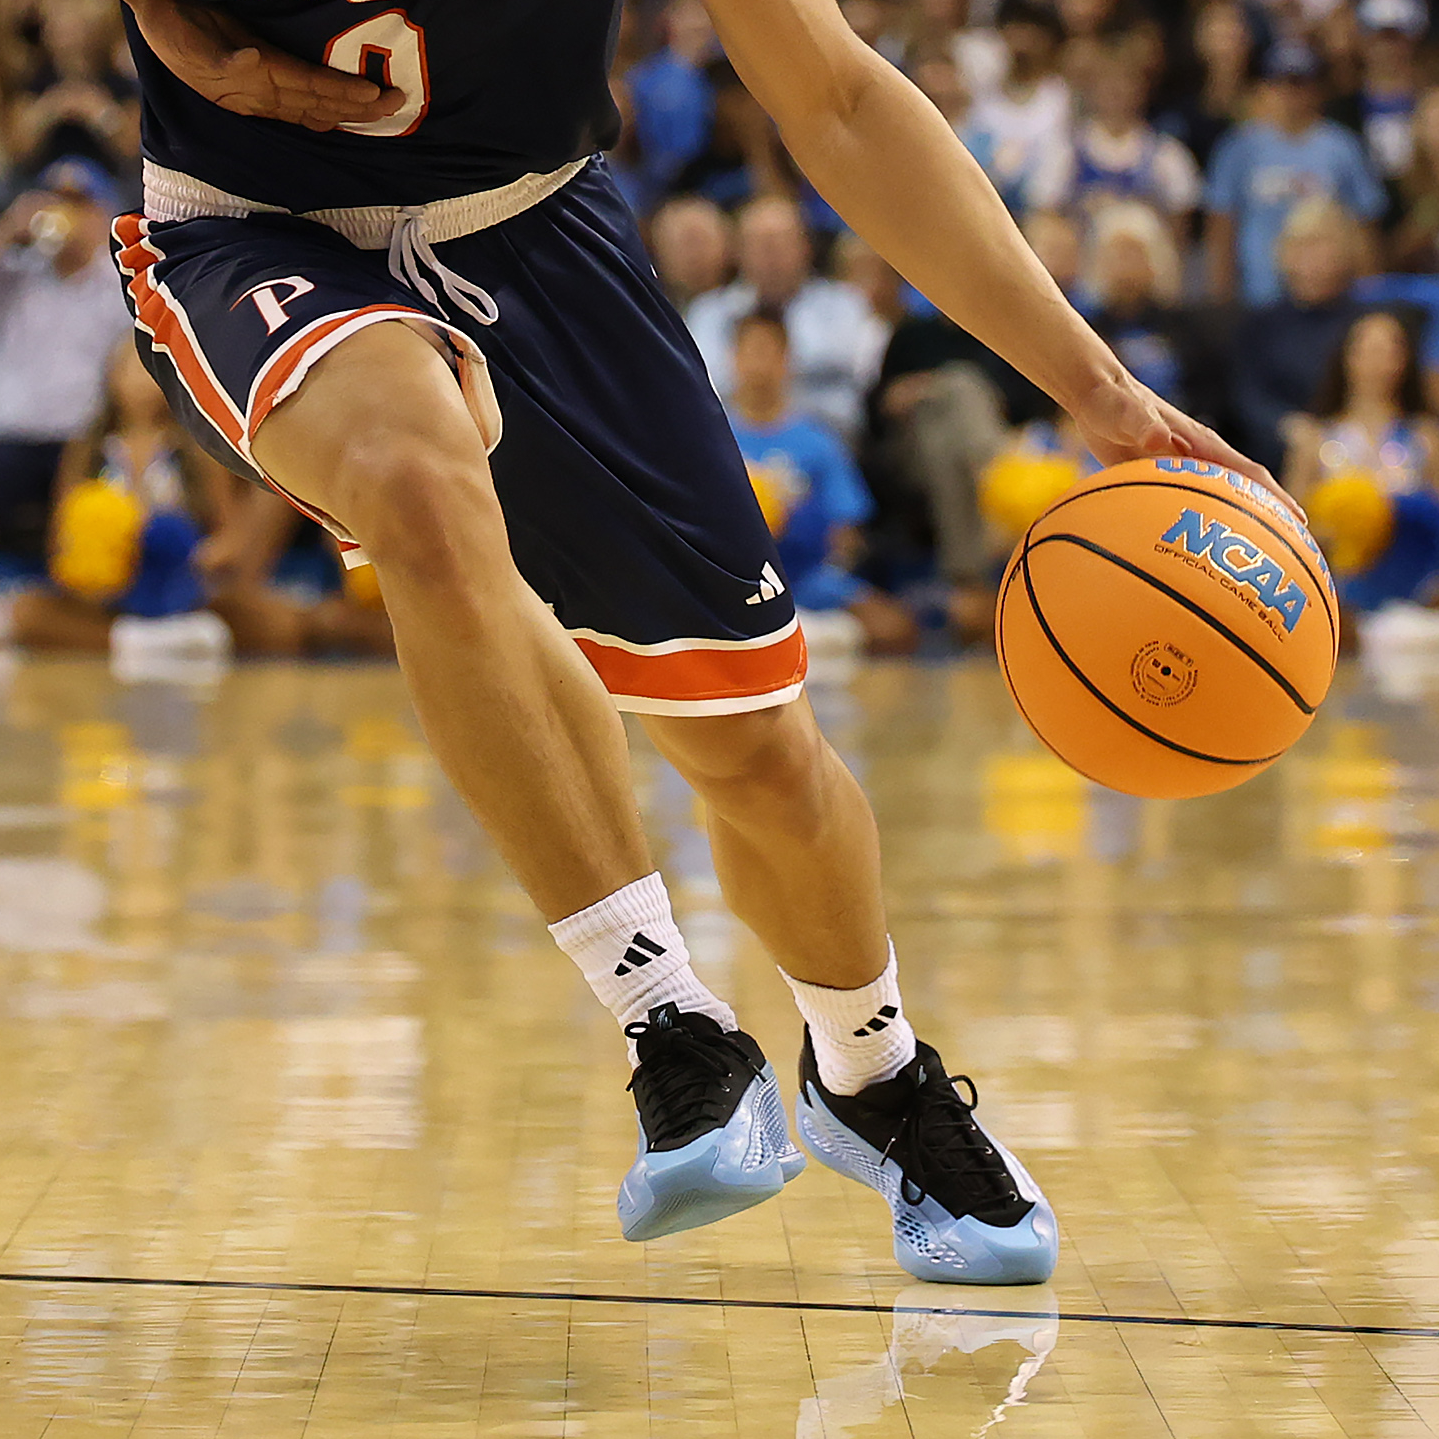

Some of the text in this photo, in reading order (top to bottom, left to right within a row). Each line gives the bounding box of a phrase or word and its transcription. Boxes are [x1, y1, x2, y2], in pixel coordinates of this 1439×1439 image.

[321, 7, 431, 138] 0
[228, 274, 318, 337] P
[1153, 543, 1285, 644] OFFICIAL GAME BALL
[1160, 506, 1309, 634] NCAA
